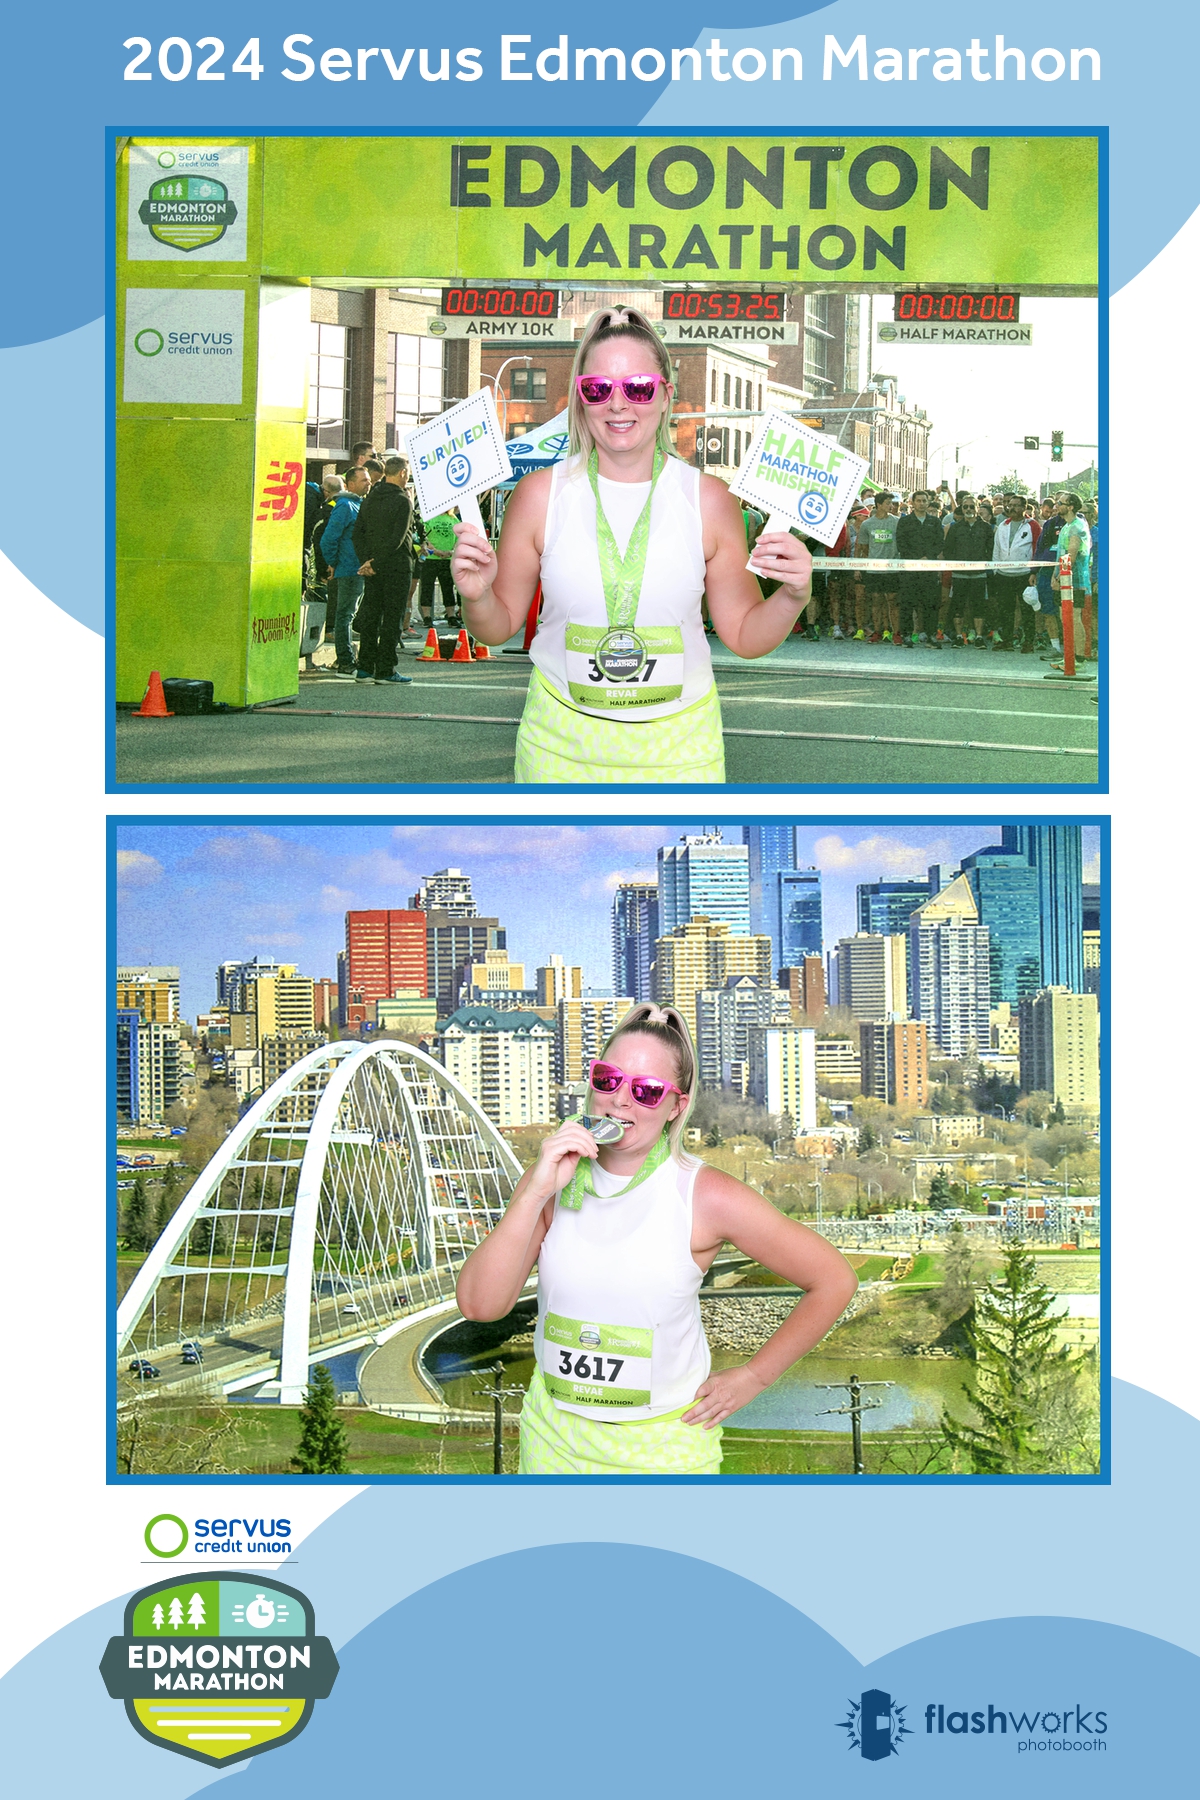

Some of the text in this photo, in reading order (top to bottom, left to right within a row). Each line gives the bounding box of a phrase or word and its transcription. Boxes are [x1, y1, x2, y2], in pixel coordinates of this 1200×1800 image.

[178, 152, 220, 161] servus
[450, 144, 990, 211] EDMONTON
[149, 203, 227, 214] EDMONTON
[160, 214, 215, 222] MARATHON
[523, 222, 907, 272] MARATHON
[466, 321, 554, 336] ARMY 10K
[679, 325, 785, 340] MARATHON
[900, 327, 1031, 341] HALF MARATHON
[168, 332, 233, 345] servus
[168, 345, 233, 355] credit union
[445, 422, 452, 436] I
[419, 421, 488, 471] SURVIVED!
[763, 429, 845, 473] HALF
[760, 451, 839, 487] MARATHON
[606, 689, 638, 698] REVAE
[628, 697, 666, 705] MARATHON
[559, 1350, 625, 1382] 3617
[573, 1384, 604, 1396] REVAE
[576, 1395, 634, 1406] HALF MARATHON
